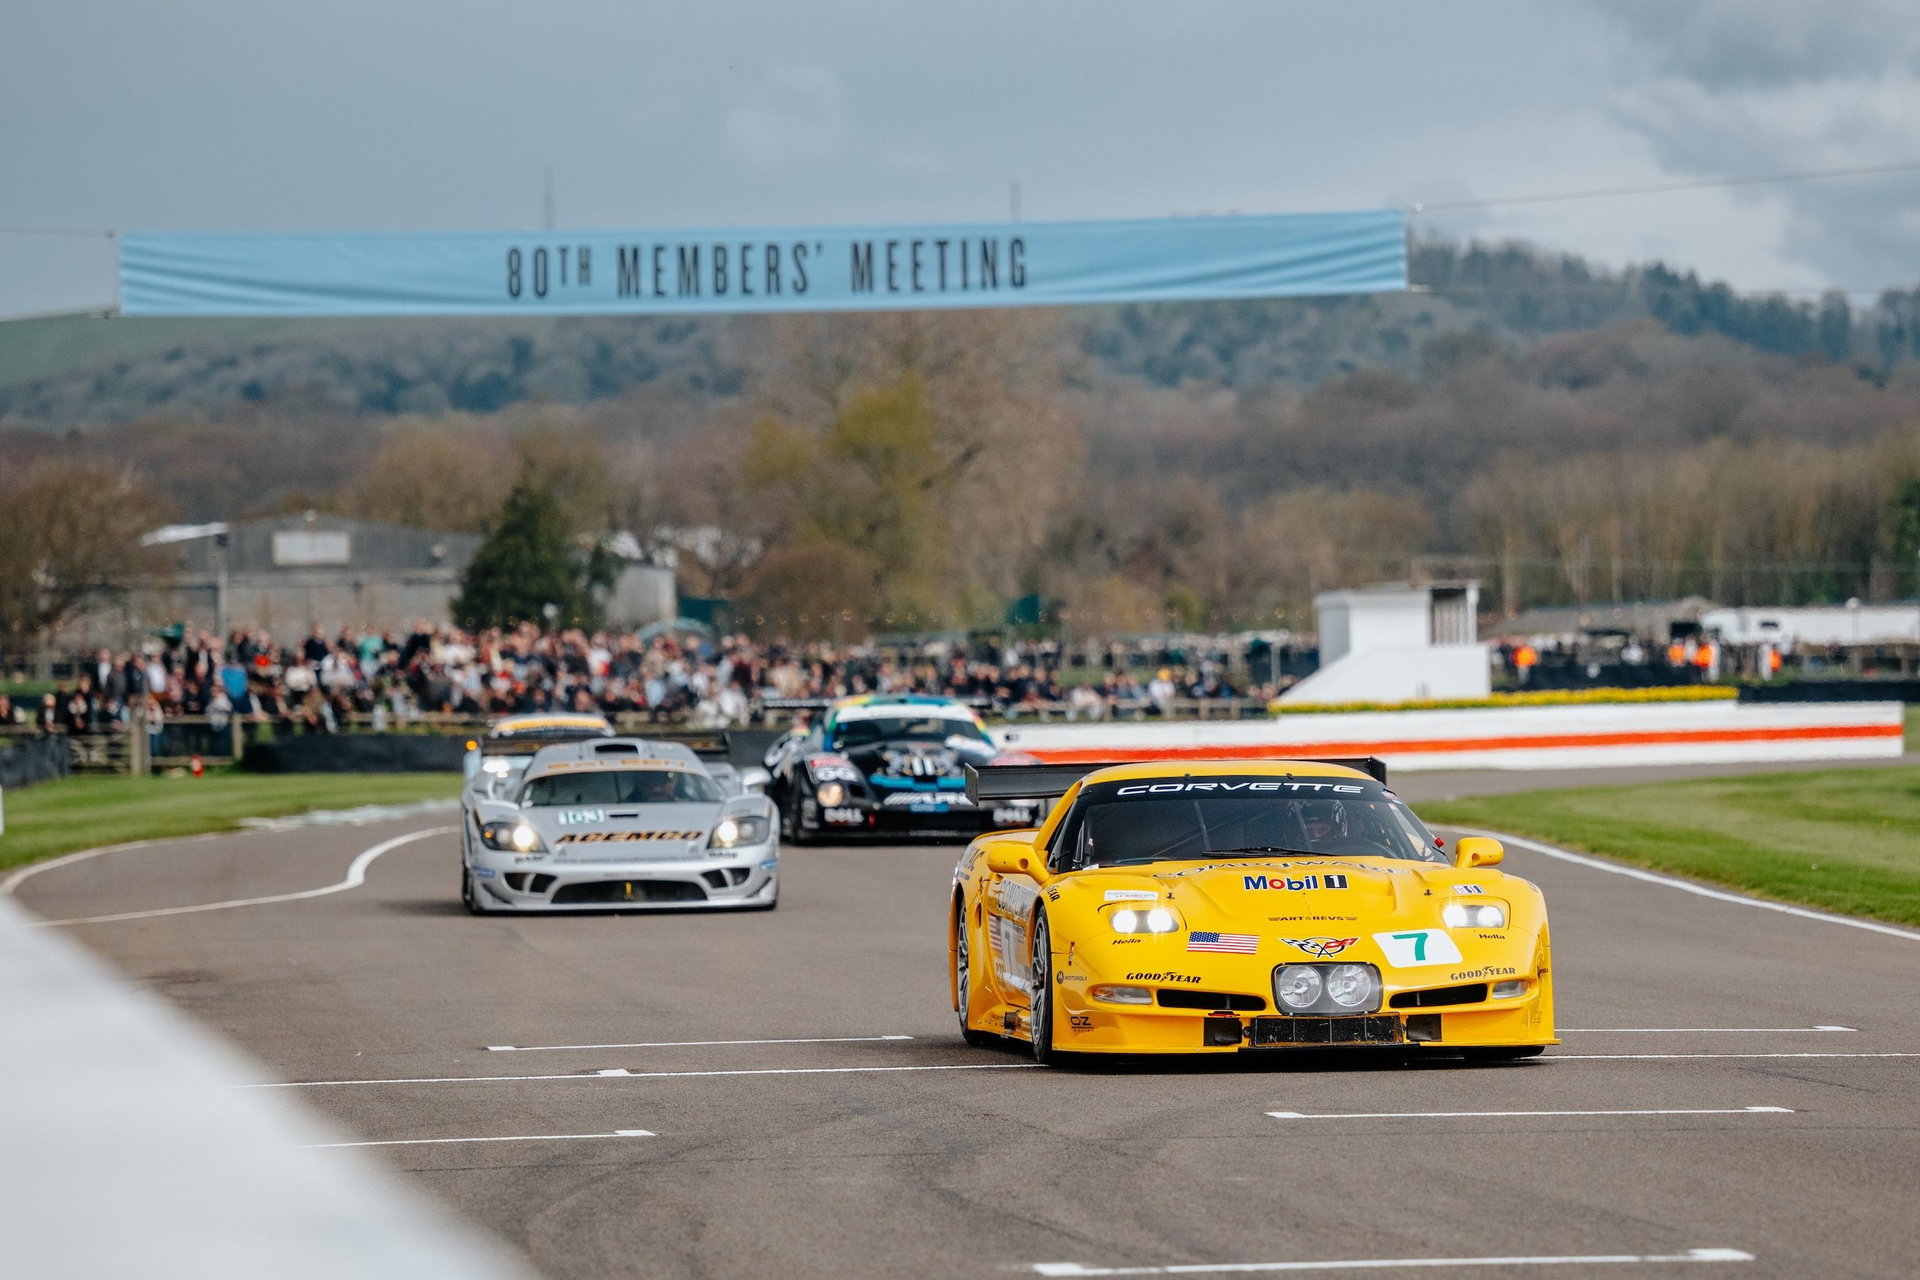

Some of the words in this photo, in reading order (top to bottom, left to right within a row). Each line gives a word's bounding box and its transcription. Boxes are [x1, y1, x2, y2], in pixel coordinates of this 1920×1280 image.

[507, 246, 591, 298] 80TH
[617, 242, 823, 297] MEMBERS'
[851, 238, 1026, 293] MEETING
[1116, 781, 1365, 796] CORVETTE
[564, 808, 601, 824] 163
[553, 829, 704, 846] ACEMCO
[1243, 875, 1319, 891] Mobil
[1391, 932, 1429, 961] 7
[1070, 1016, 1092, 1026] OZ
